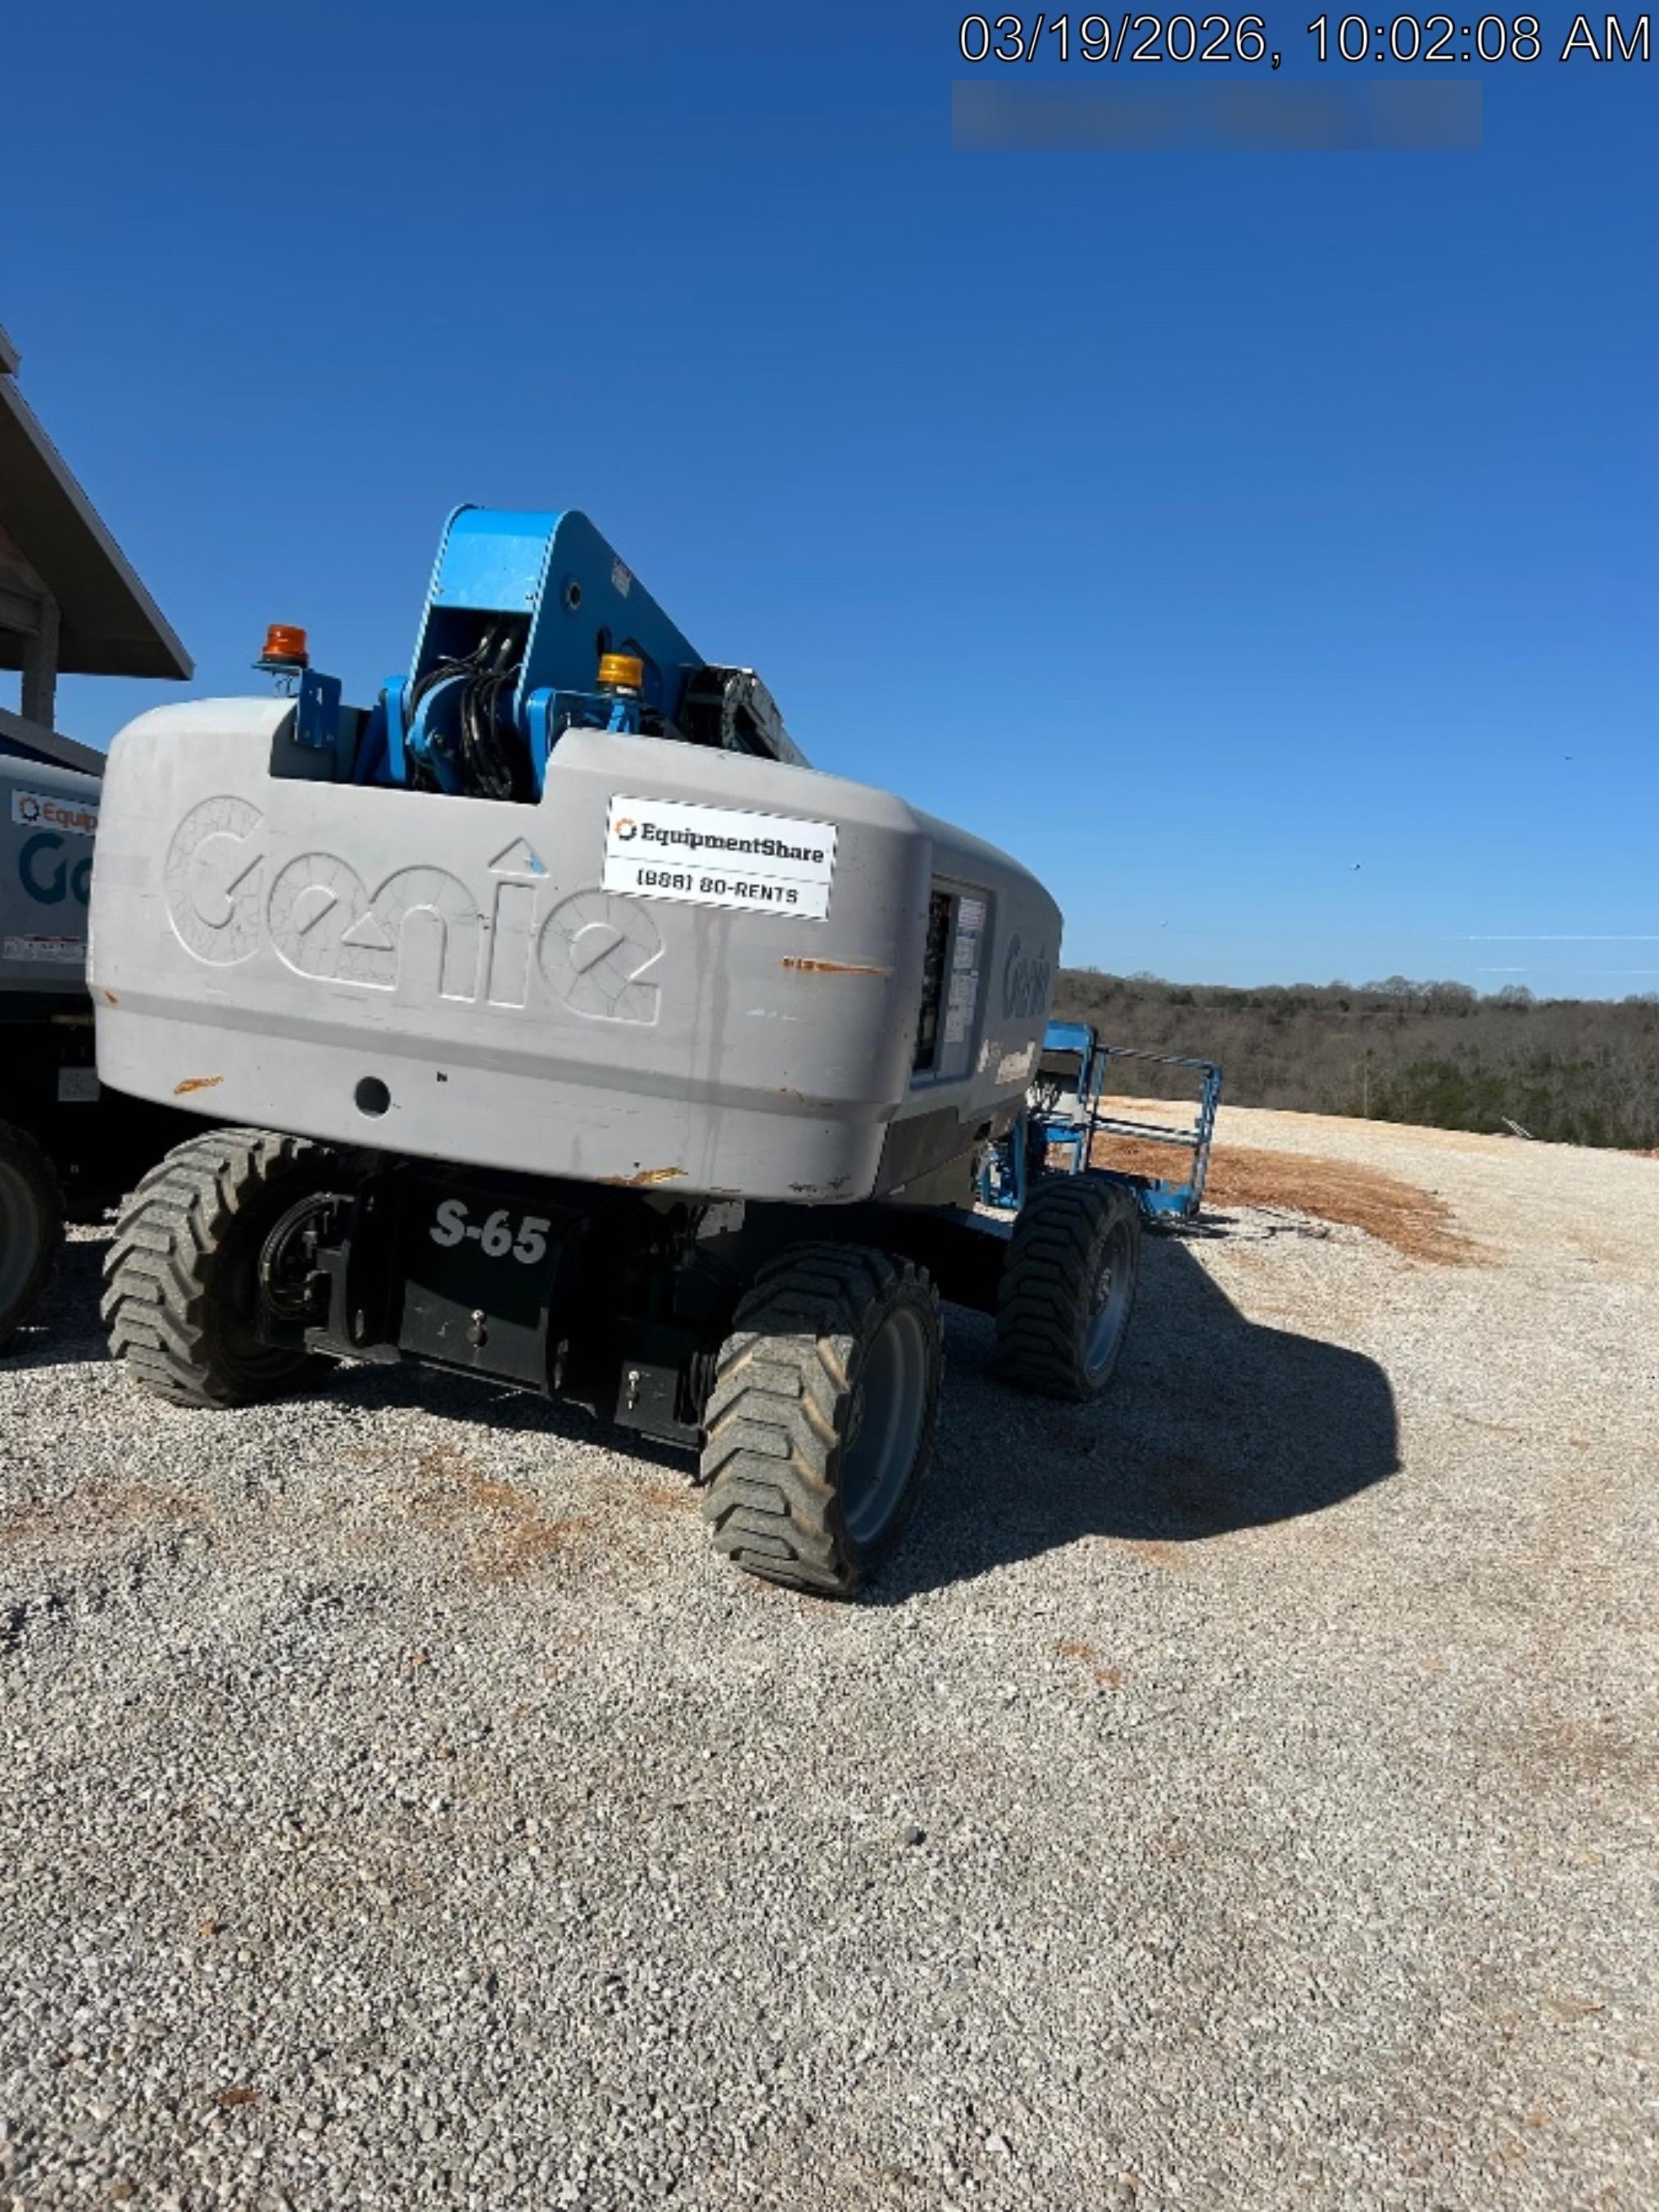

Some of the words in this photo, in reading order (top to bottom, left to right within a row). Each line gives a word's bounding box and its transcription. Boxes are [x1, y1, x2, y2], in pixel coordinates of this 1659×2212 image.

[641, 822, 825, 863] EquipmentShare
[165, 794, 665, 1026] Genie
[700, 877, 800, 904] 80-RENTS
[429, 1199, 551, 1264] S-65
